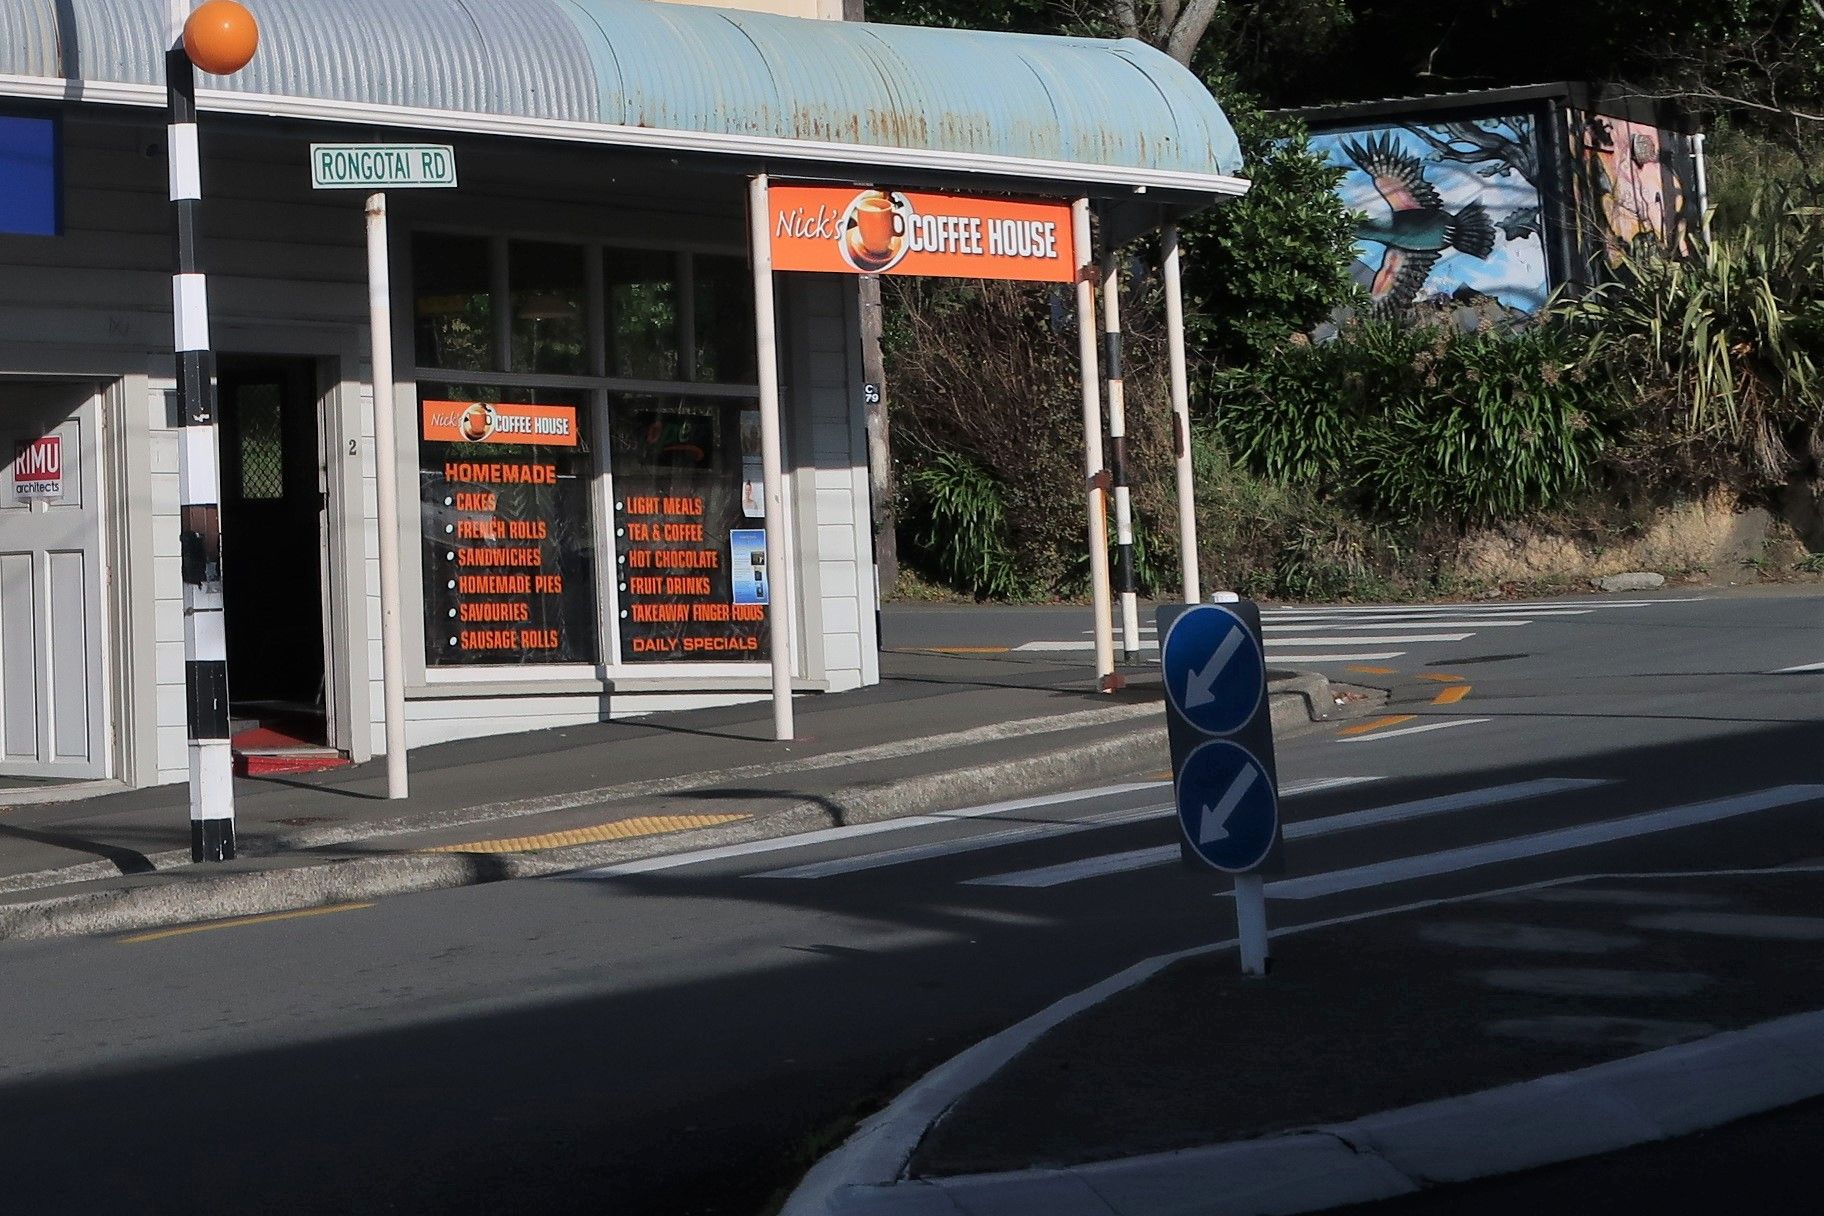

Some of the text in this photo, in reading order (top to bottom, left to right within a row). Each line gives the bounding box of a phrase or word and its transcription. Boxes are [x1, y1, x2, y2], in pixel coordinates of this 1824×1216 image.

[321, 152, 446, 180] RONGOTAI RD
[776, 204, 1058, 258] Nick's COFFEE HOUSE
[865, 384, 874, 394] C
[865, 393, 879, 403] 79
[495, 415, 532, 433] COFFEE
[534, 417, 569, 435] HOUSE
[349, 439, 357, 456] 2
[16, 443, 59, 475] RIMU
[444, 463, 557, 484] HOMEMADE
[16, 481, 60, 493] architects
[456, 493, 497, 511] CAKES
[627, 497, 703, 515] LIGHT MEALS
[457, 520, 547, 539] FRENCH ROLLS
[628, 524, 704, 542] TEA & COFFEE
[458, 548, 542, 566] SANDWICHES
[629, 550, 652, 568] HOT
[655, 550, 719, 569] CHOCOLATE
[459, 575, 562, 594] HOMEMADE PIES
[630, 577, 711, 595] FRUIT DRINKS
[460, 603, 529, 621] SAVOURIES
[631, 604, 764, 622] TAKEAWAY FINGER FOODS
[460, 630, 558, 649] SAUSAGE ROLLS
[633, 637, 758, 652] DAILY SPECIALS
